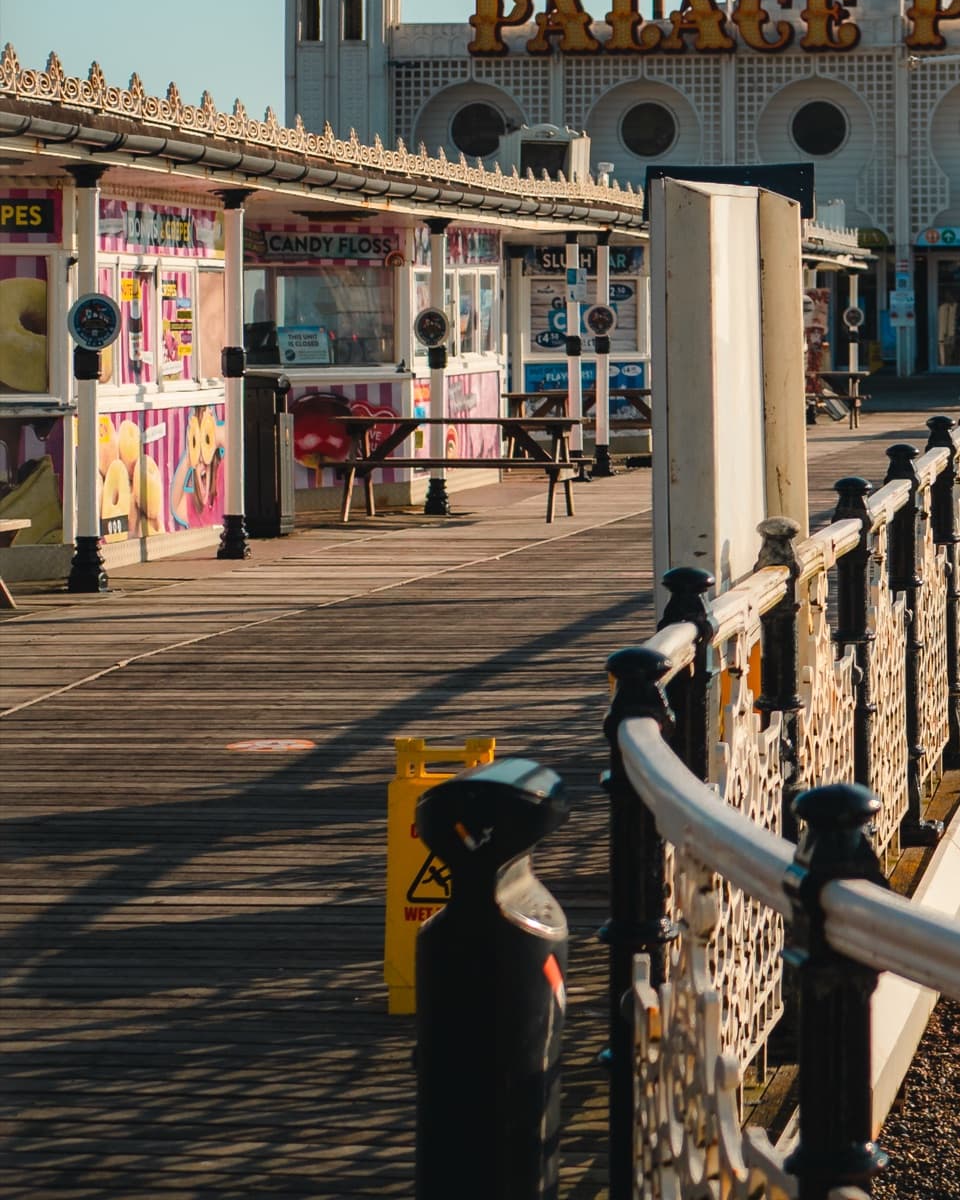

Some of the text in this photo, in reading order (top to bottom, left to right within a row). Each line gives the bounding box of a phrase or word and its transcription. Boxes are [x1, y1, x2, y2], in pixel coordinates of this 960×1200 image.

[269, 235, 392, 254] CANDY FLOSS
[543, 253, 626, 268] SLUH AR
